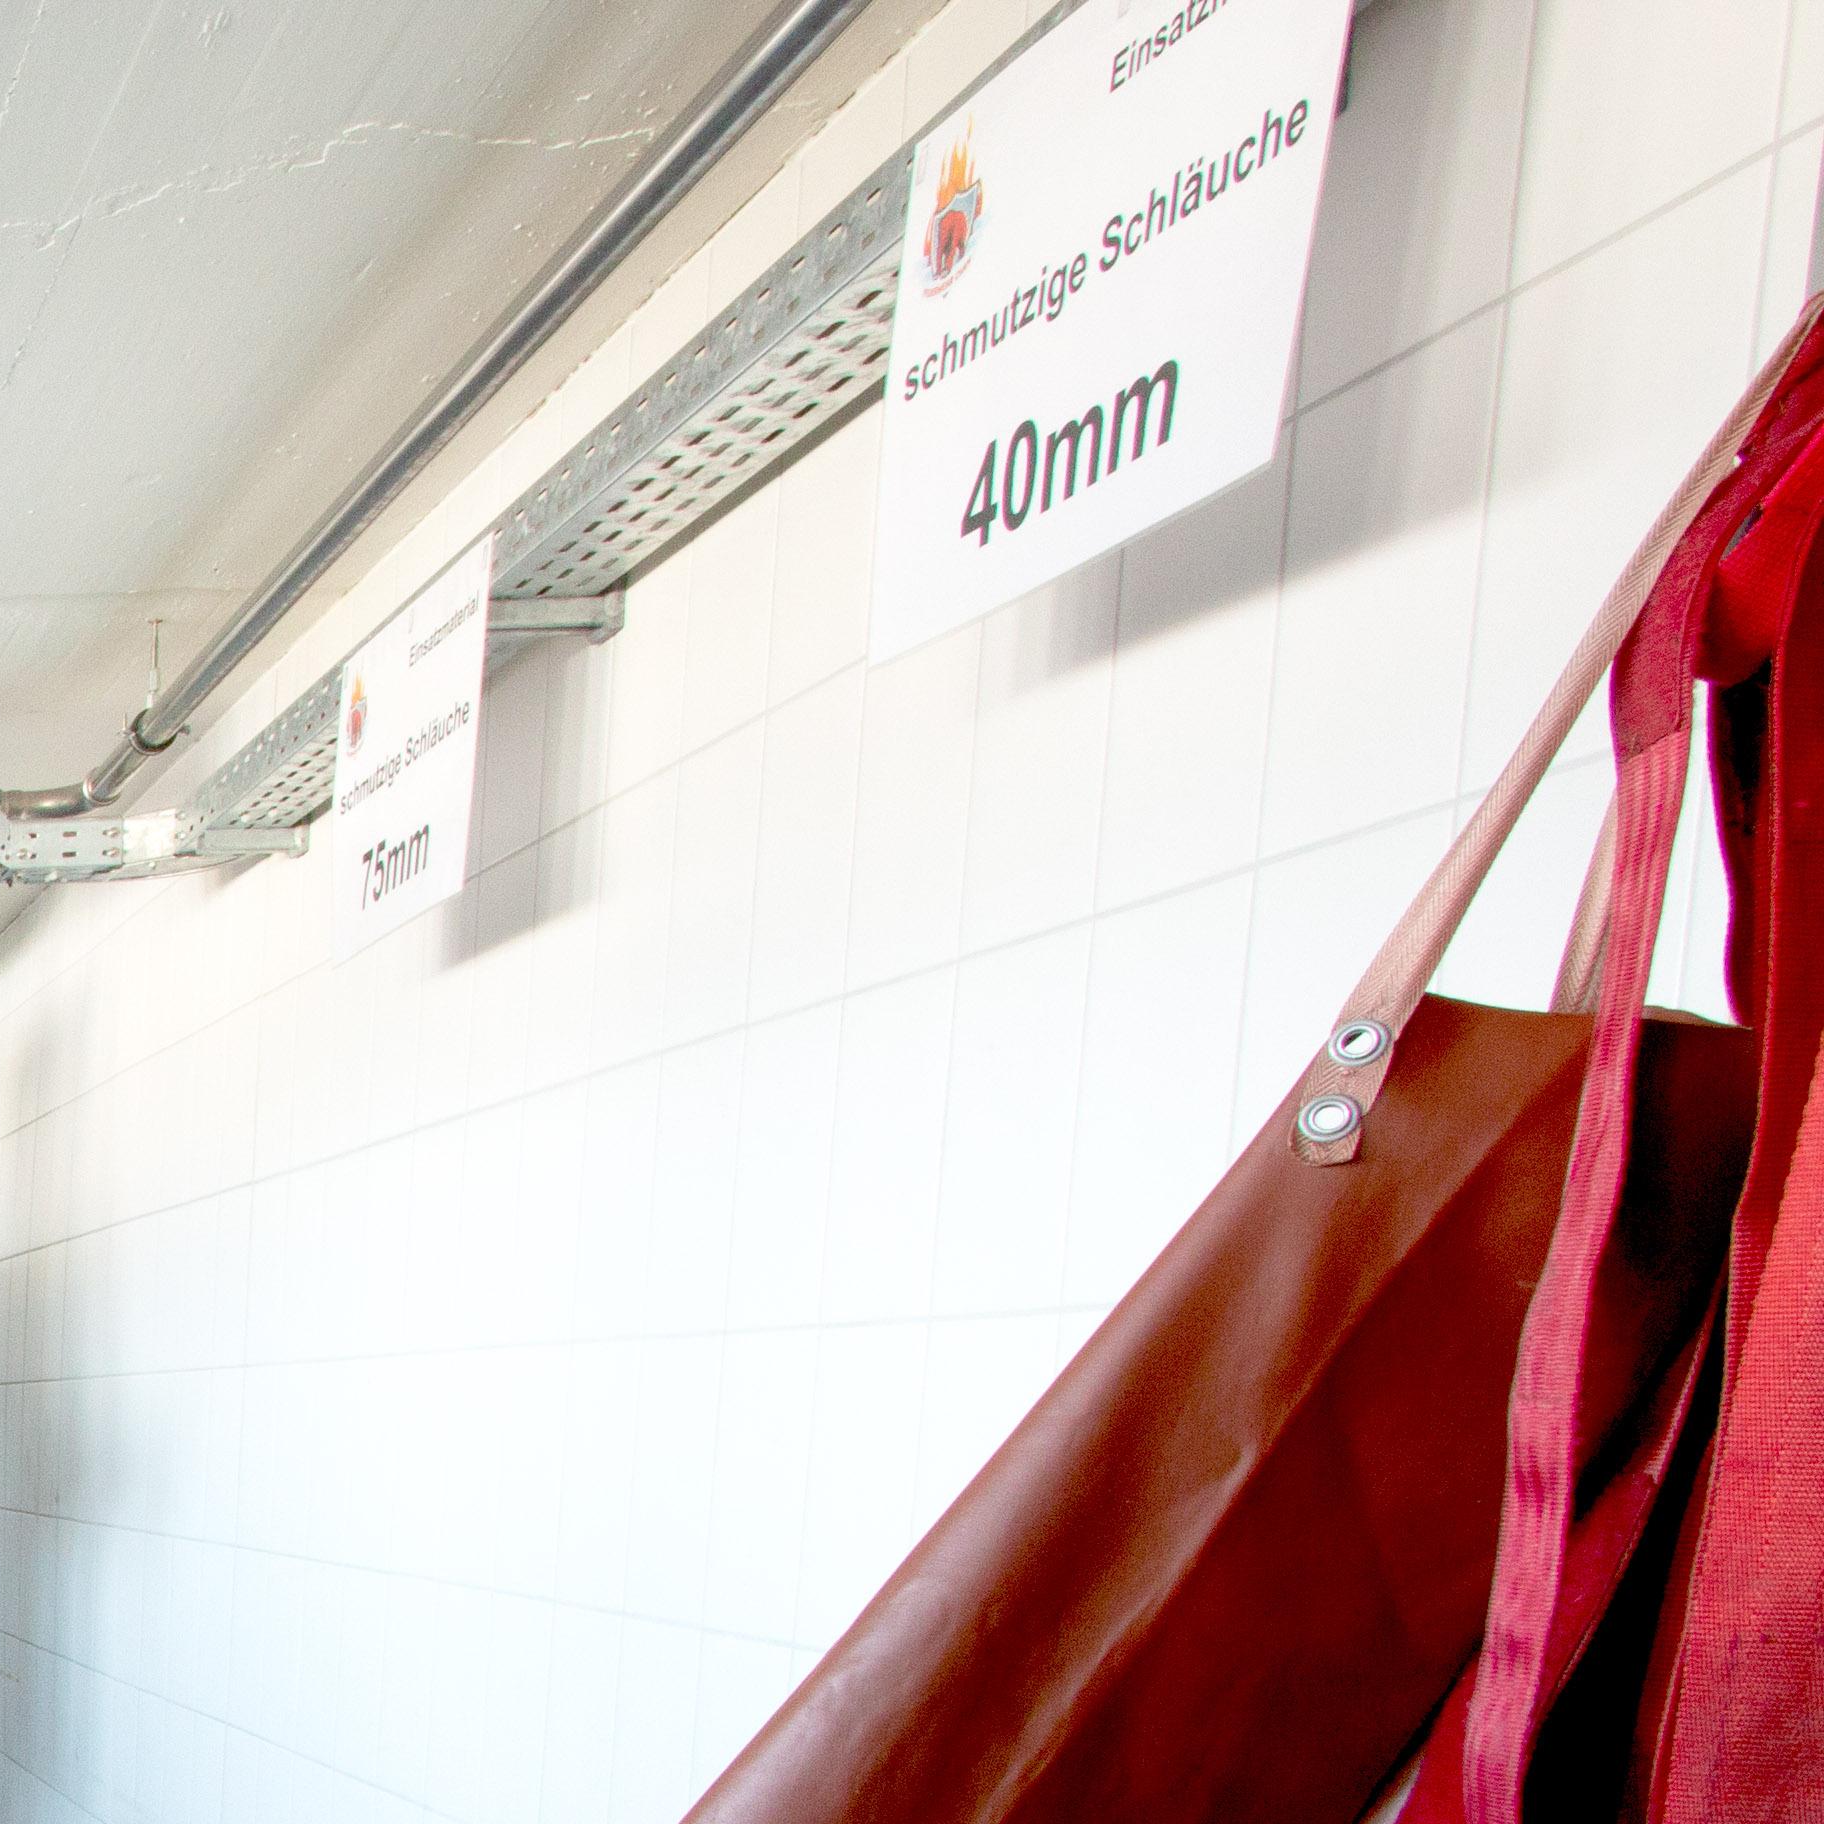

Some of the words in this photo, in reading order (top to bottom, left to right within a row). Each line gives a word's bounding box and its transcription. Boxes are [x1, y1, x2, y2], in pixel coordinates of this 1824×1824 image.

[1110, 0, 1227, 93] Einsatz
[902, 249, 1086, 402] schmutzige
[1099, 97, 1310, 273] Schläuche
[960, 358, 1179, 548] 40mm
[408, 589, 480, 668] Einsatzmaterial
[339, 751, 402, 816] schmutzige
[404, 699, 470, 767] Schläuche
[361, 823, 430, 911] 75mm
